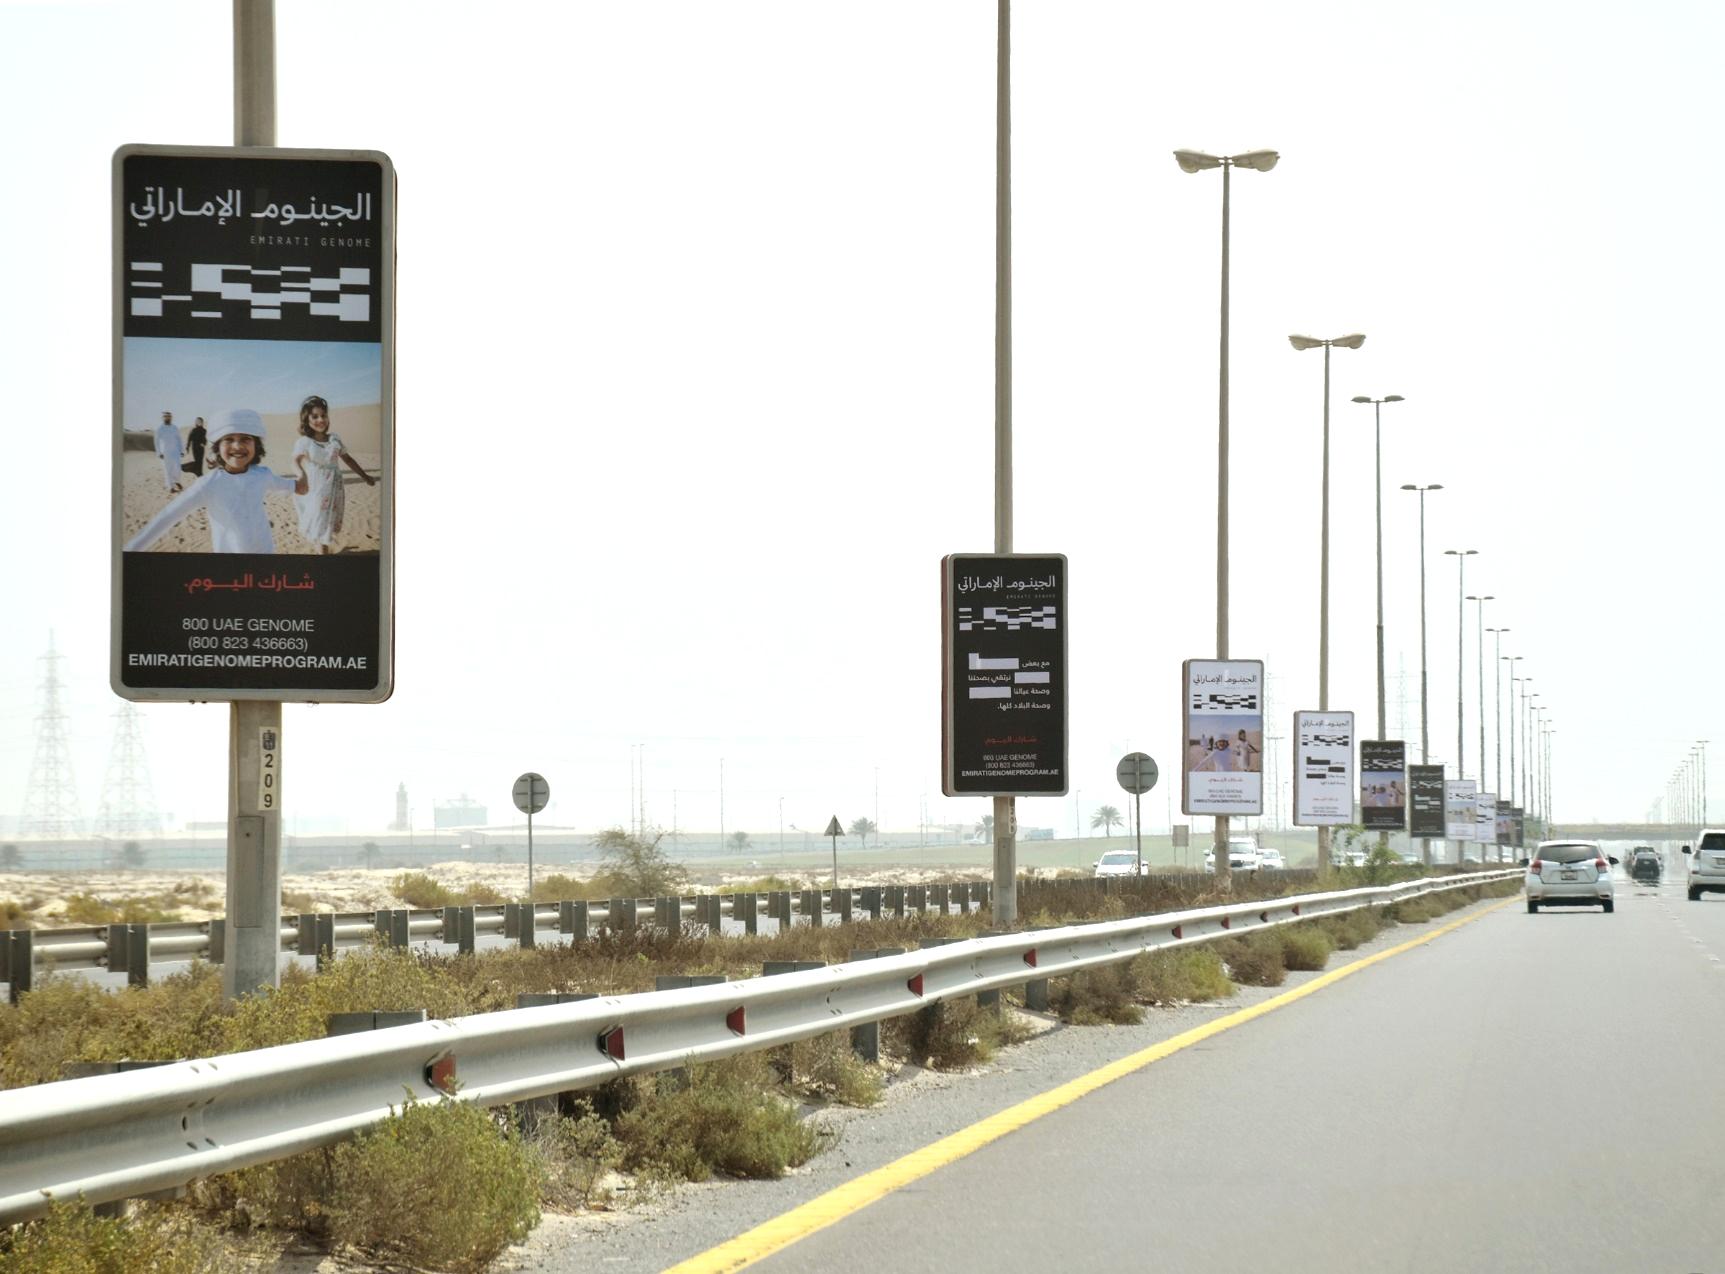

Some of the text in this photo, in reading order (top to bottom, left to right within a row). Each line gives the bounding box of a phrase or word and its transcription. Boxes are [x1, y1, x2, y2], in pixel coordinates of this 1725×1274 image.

[130, 186, 241, 228] الإماراتي
[250, 235, 372, 248] EMIRATI GENOME
[258, 573, 314, 591] شارك
[182, 618, 315, 632] 800 UAE GENOME
[188, 636, 309, 652] (800 823 436663)
[128, 653, 367, 670] EMIRATIGENOMEPROGRAM.AE
[264, 753, 274, 808] 209
[961, 769, 1059, 777] EMIRATIGENOMEPROGRAM.AE
